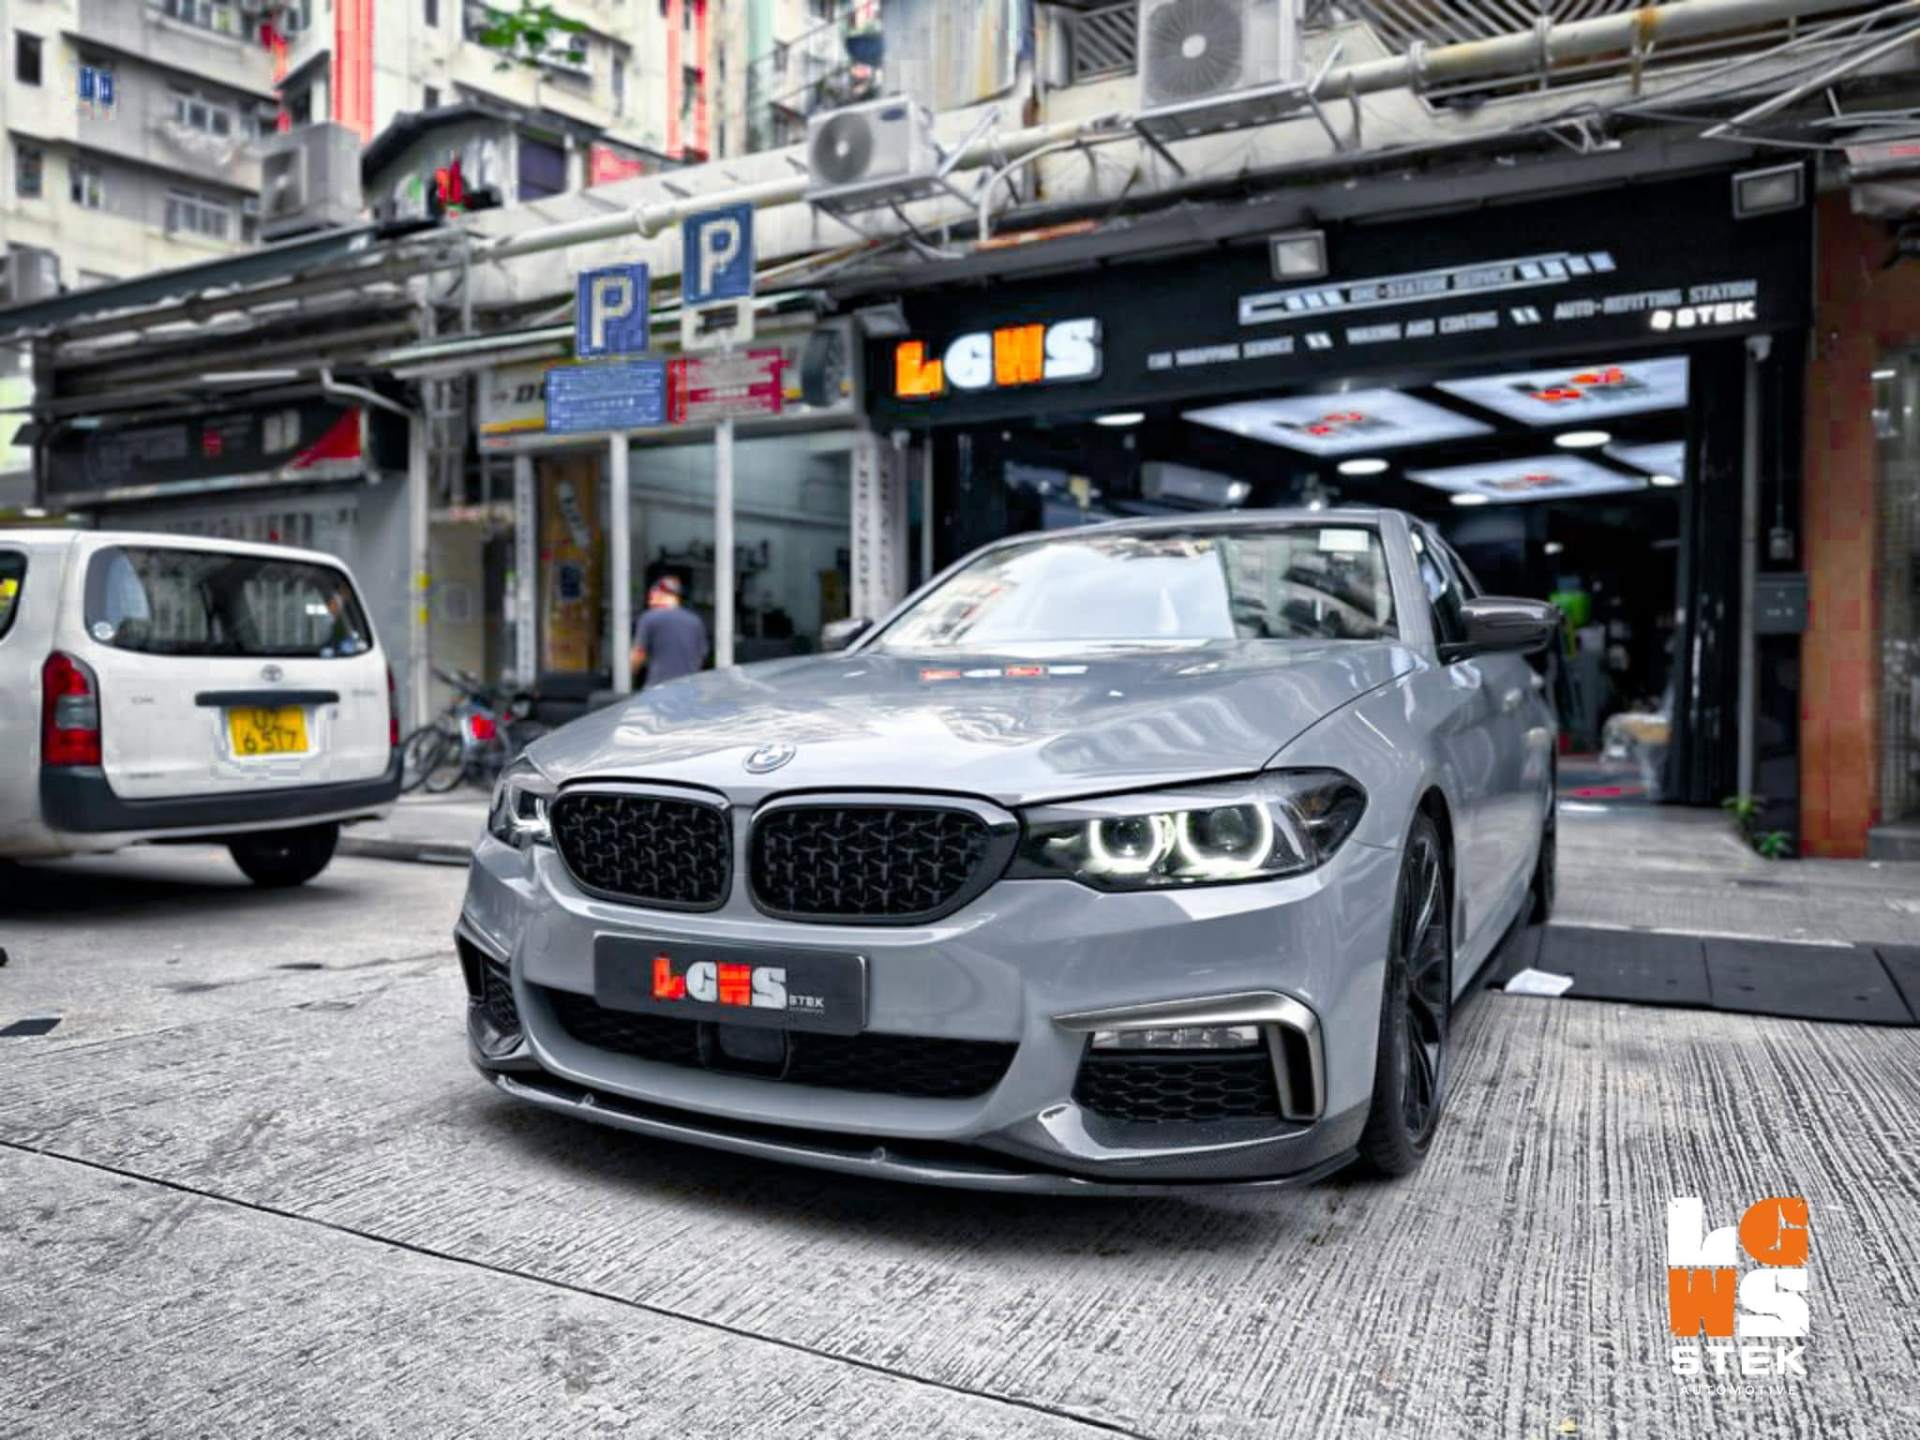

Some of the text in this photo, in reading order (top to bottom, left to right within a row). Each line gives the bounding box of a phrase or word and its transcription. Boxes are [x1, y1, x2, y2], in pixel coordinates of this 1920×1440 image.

[699, 217, 741, 296] P
[590, 275, 634, 349] P
[1675, 300, 1757, 328] STEK
[789, 994, 825, 1009] STEK
